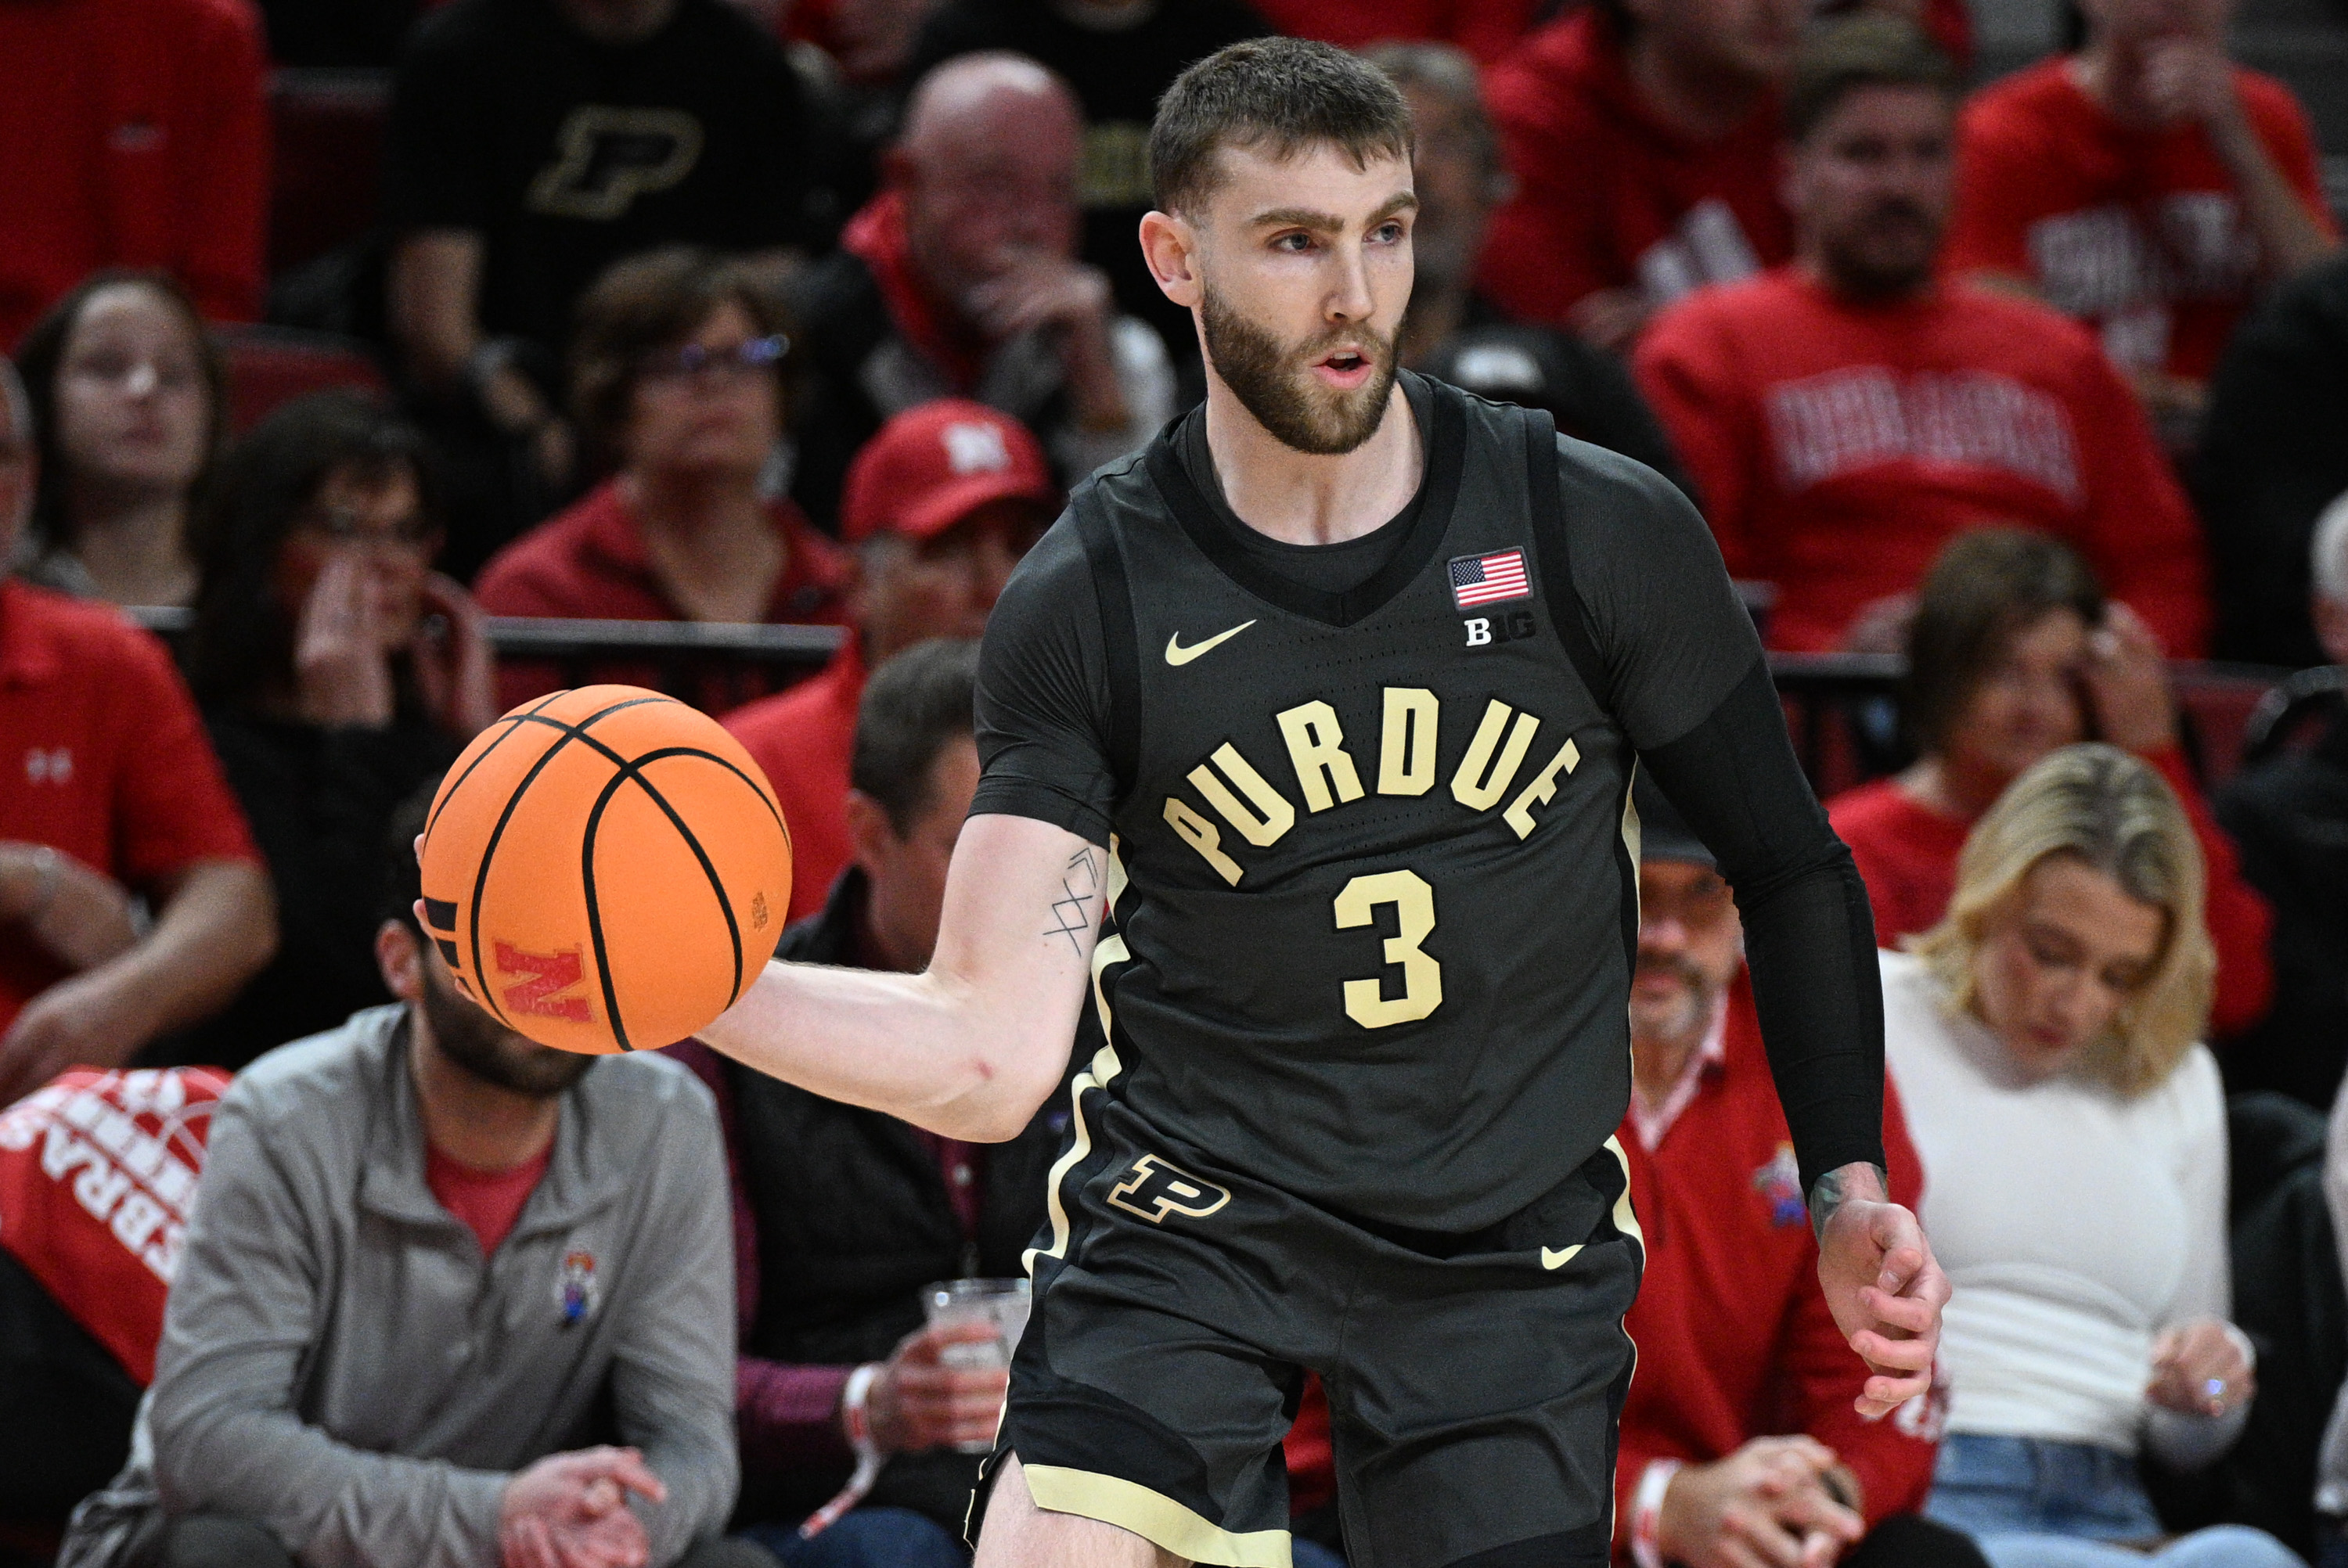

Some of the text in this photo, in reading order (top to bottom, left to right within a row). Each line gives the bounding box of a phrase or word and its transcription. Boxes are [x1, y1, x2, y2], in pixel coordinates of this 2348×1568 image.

[1161, 685, 1582, 888] PURDUE
[493, 938, 596, 1023] N
[1332, 868, 1443, 1030] 3
[1106, 1153, 1232, 1225] P
